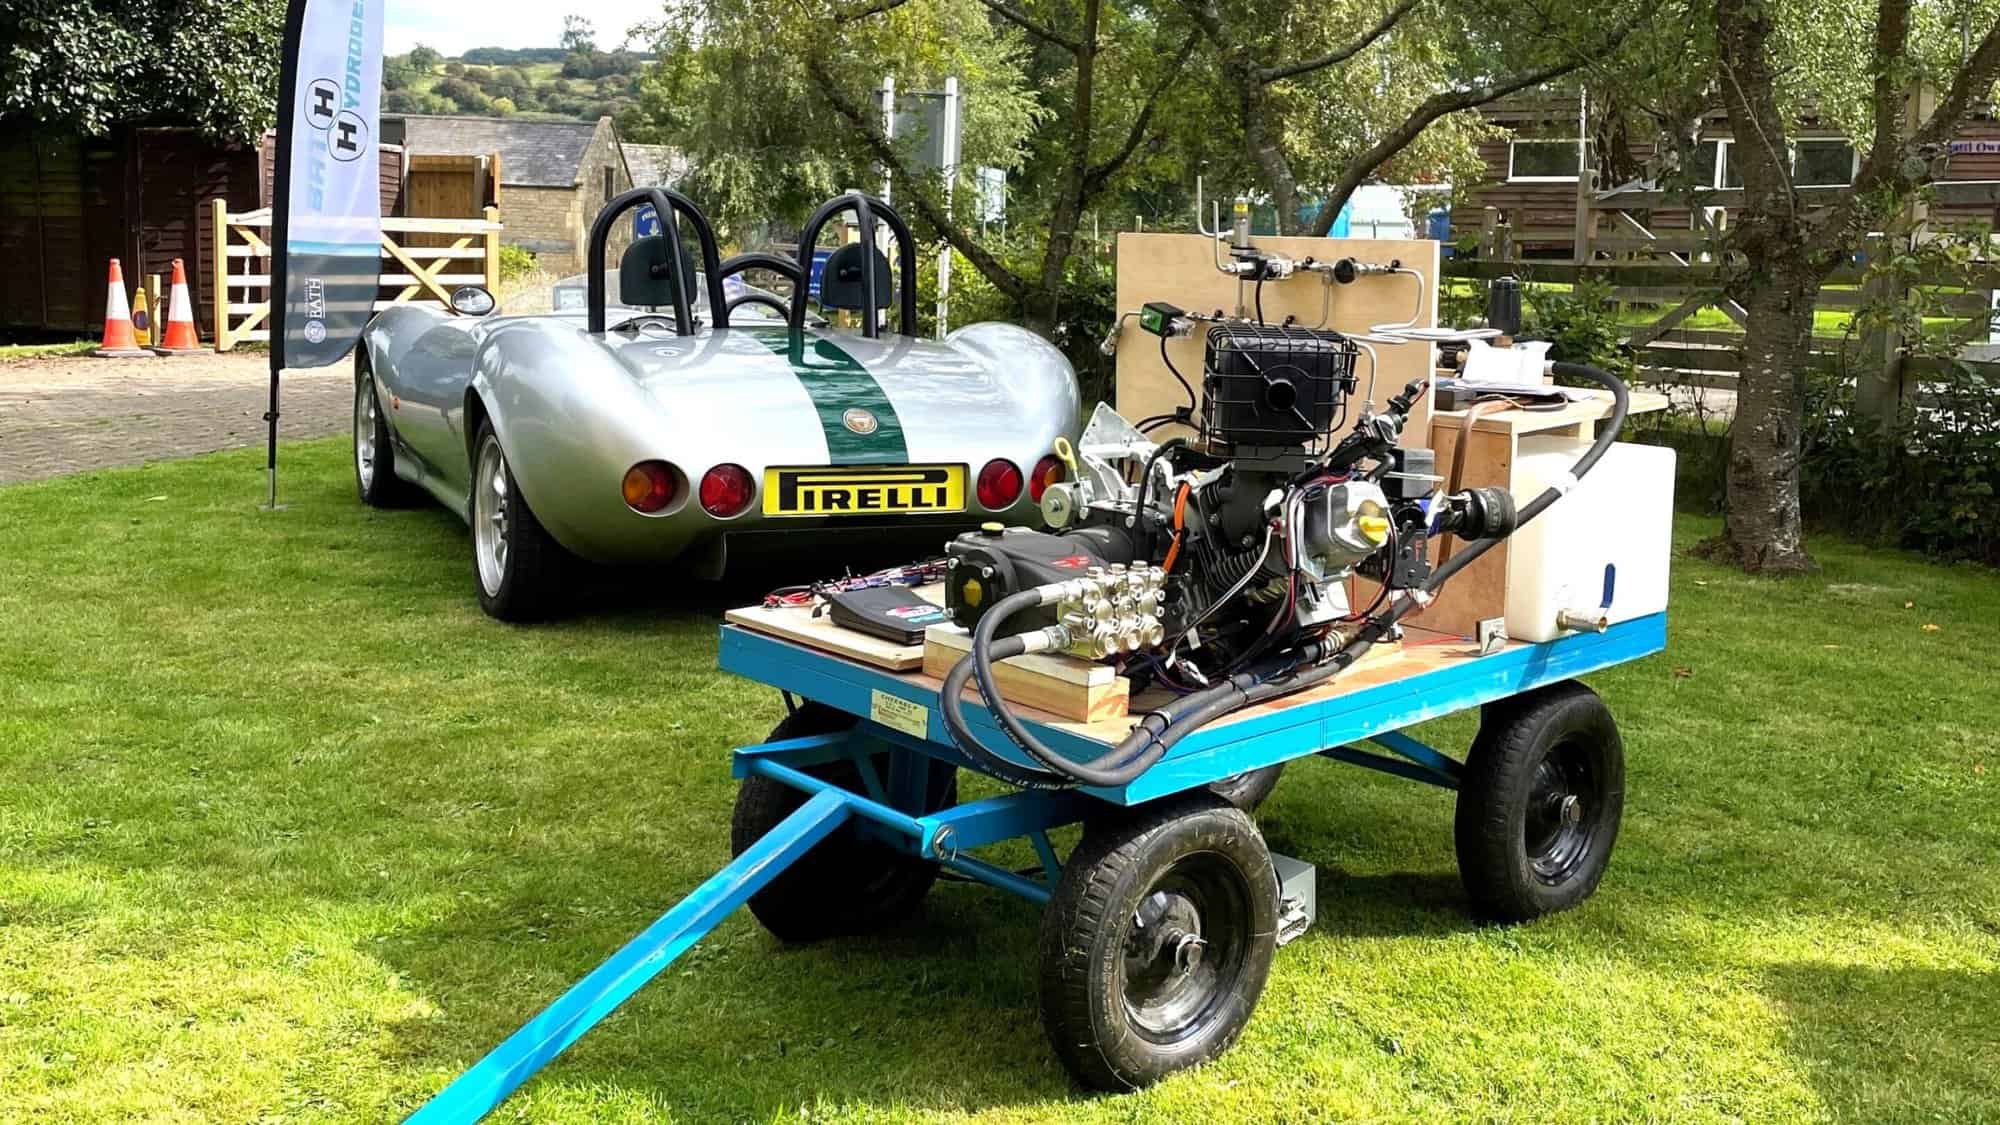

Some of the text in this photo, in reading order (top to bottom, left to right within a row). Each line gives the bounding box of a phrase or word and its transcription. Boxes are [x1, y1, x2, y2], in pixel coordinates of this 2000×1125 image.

[337, 0, 364, 152] HYDROGE
[309, 278, 322, 319] BATH
[779, 470, 948, 511] PIRELLI
